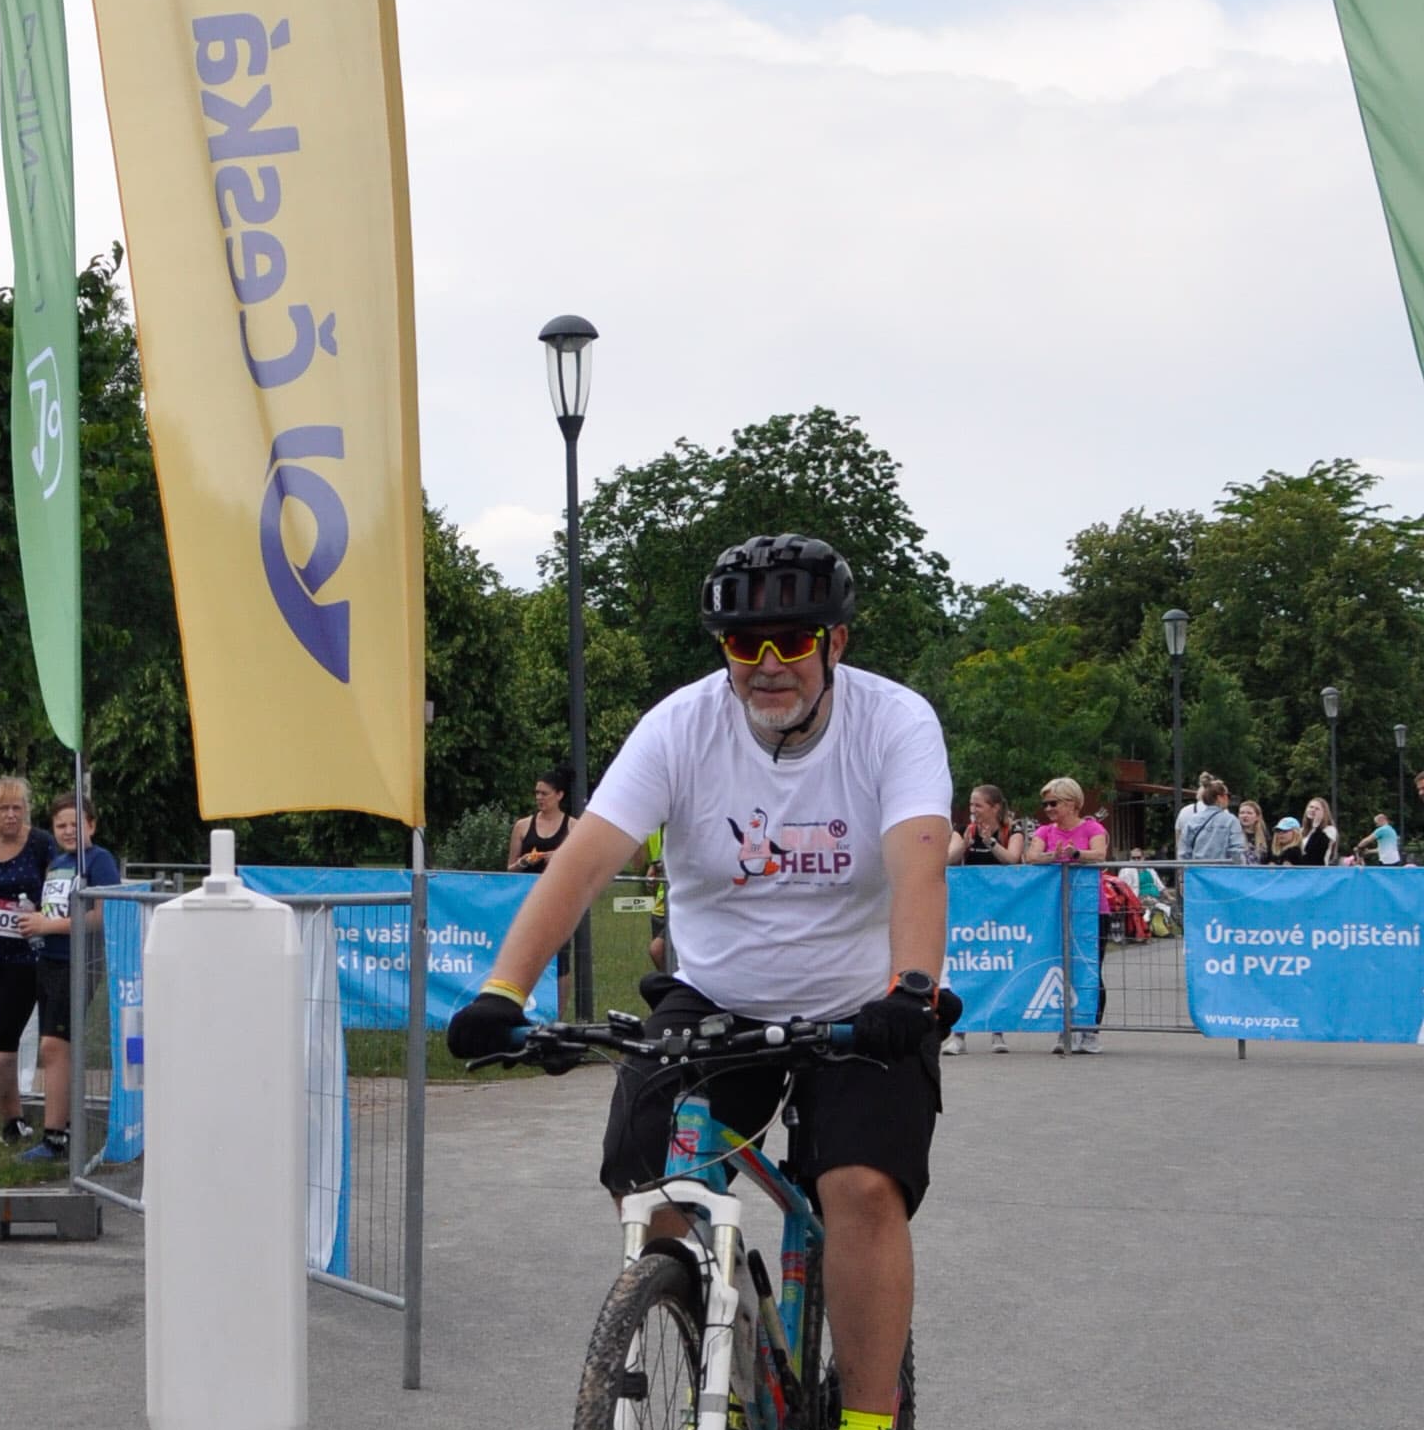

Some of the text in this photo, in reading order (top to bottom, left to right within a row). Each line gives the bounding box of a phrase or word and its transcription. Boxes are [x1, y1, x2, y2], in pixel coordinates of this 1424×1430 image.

[780, 852, 852, 874] HELP
[365, 922, 410, 944] vaši
[422, 924, 494, 949] odinu,
[951, 920, 1033, 944] rodinu,
[1205, 918, 1421, 950] Úrazové pojištění
[364, 948, 474, 975] podkání
[1204, 954, 1312, 976] od PVZP
[1204, 1012, 1300, 1029] www.pvzp.cz
